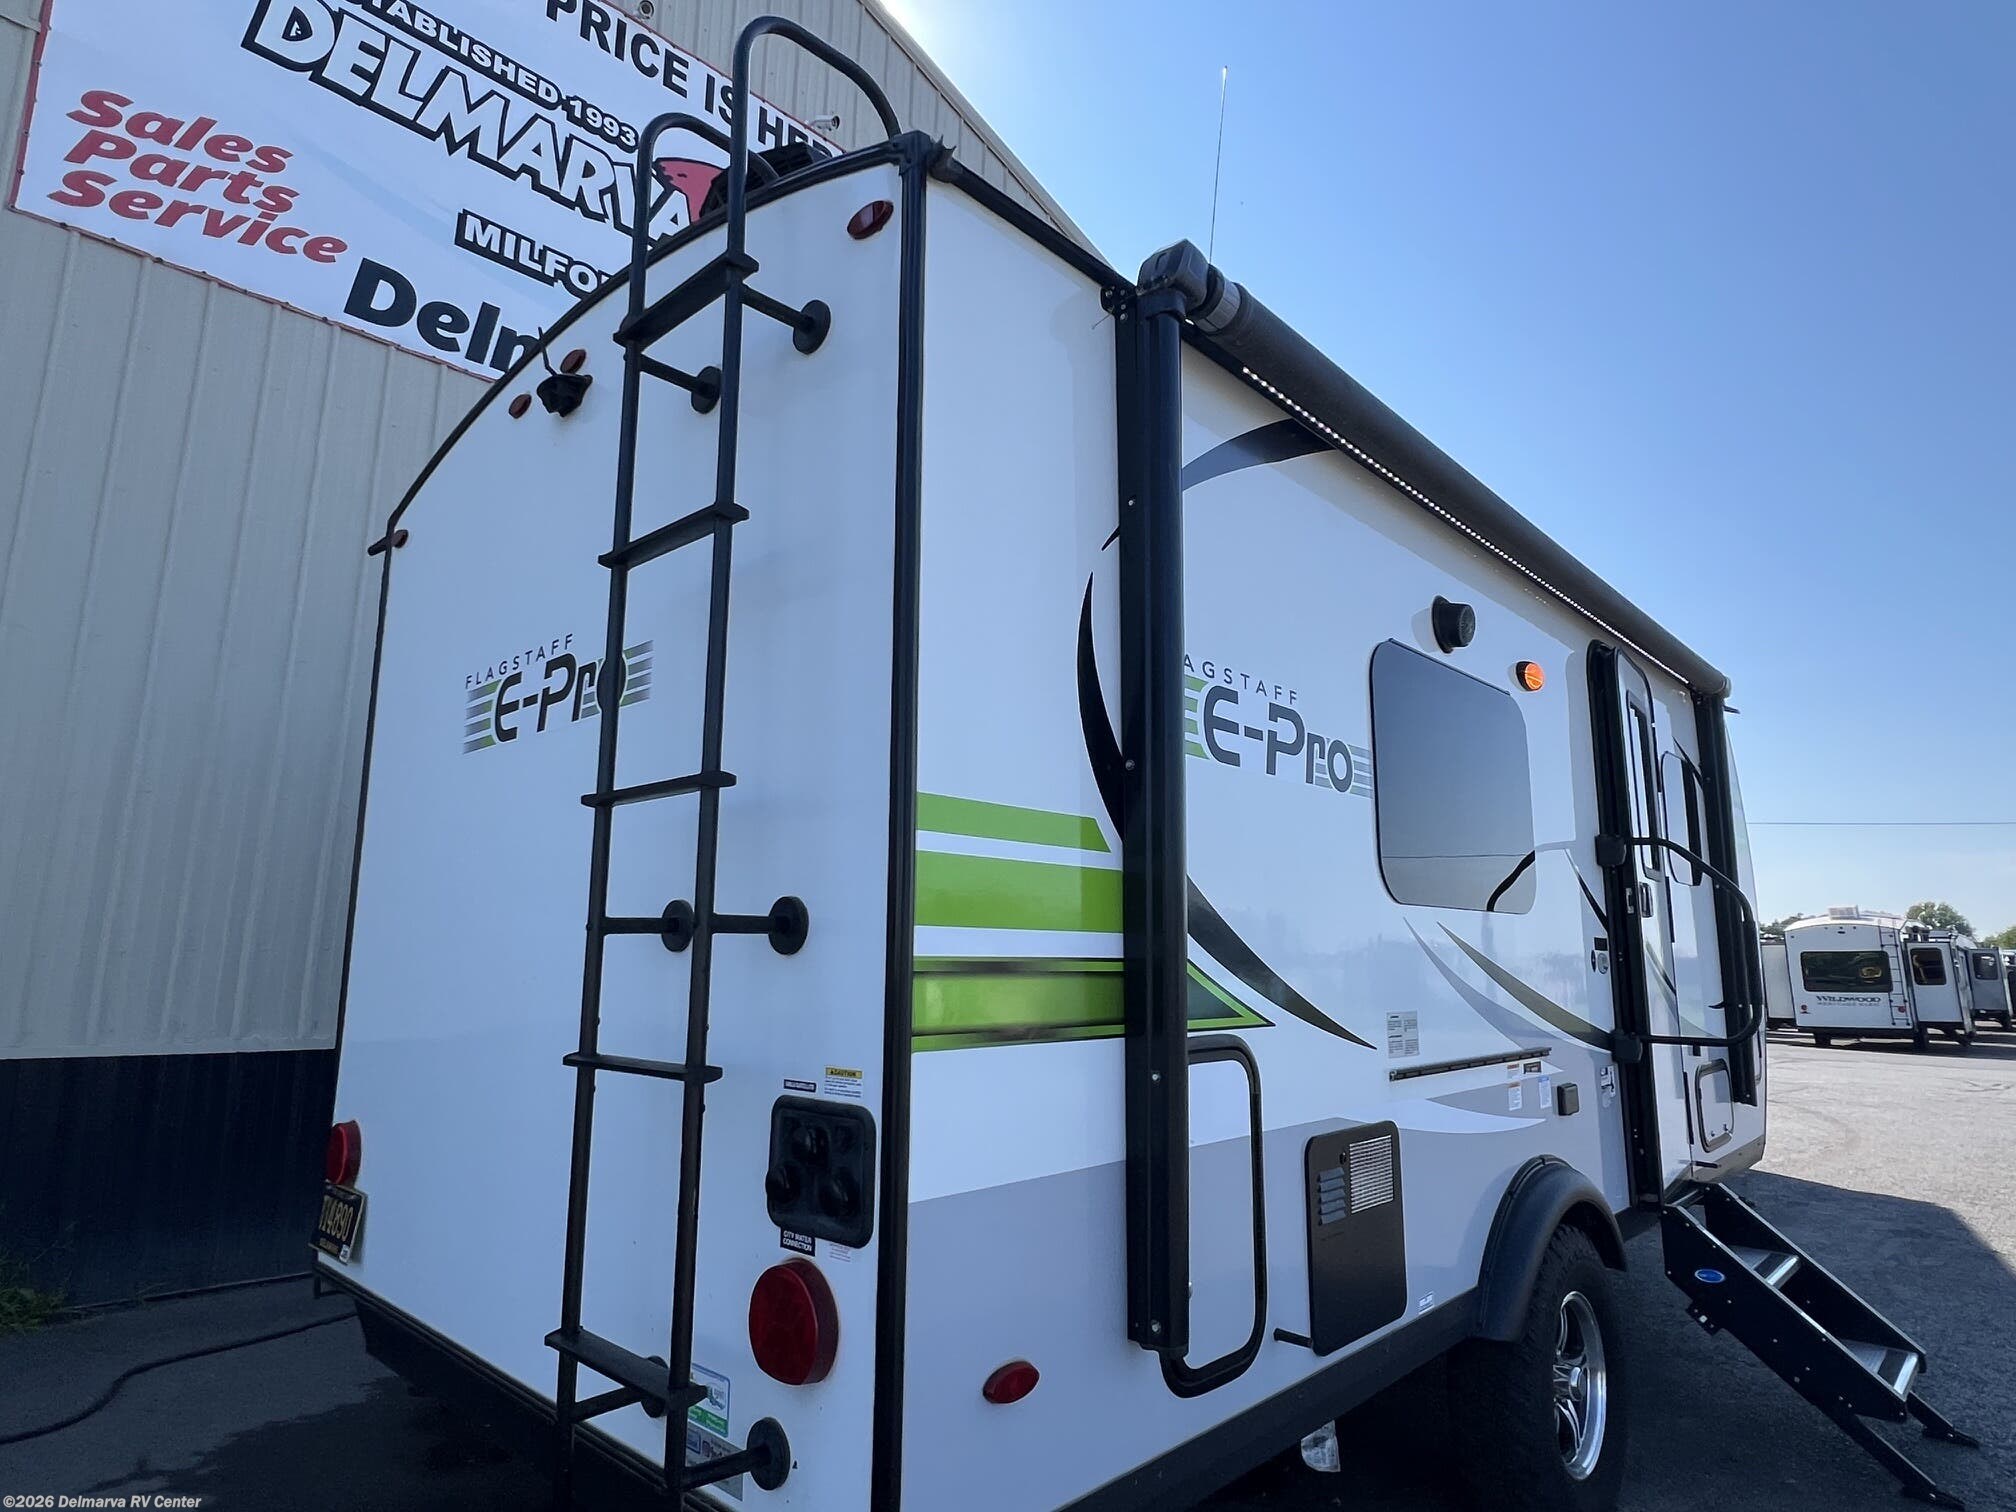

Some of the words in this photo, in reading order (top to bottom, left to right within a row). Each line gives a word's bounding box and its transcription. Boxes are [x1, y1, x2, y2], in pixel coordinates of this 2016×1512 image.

[364, 0, 561, 108] ABLISHED
[565, 95, 639, 152] 1993
[64, 130, 300, 213] Parts
[66, 90, 294, 174] Sales
[47, 170, 348, 263] Service
[454, 208, 610, 298] MILFO
[465, 633, 573, 689] FLAGSTAFF
[1184, 653, 1298, 705] AGSTAFF
[1203, 685, 1354, 793] E-Pro
